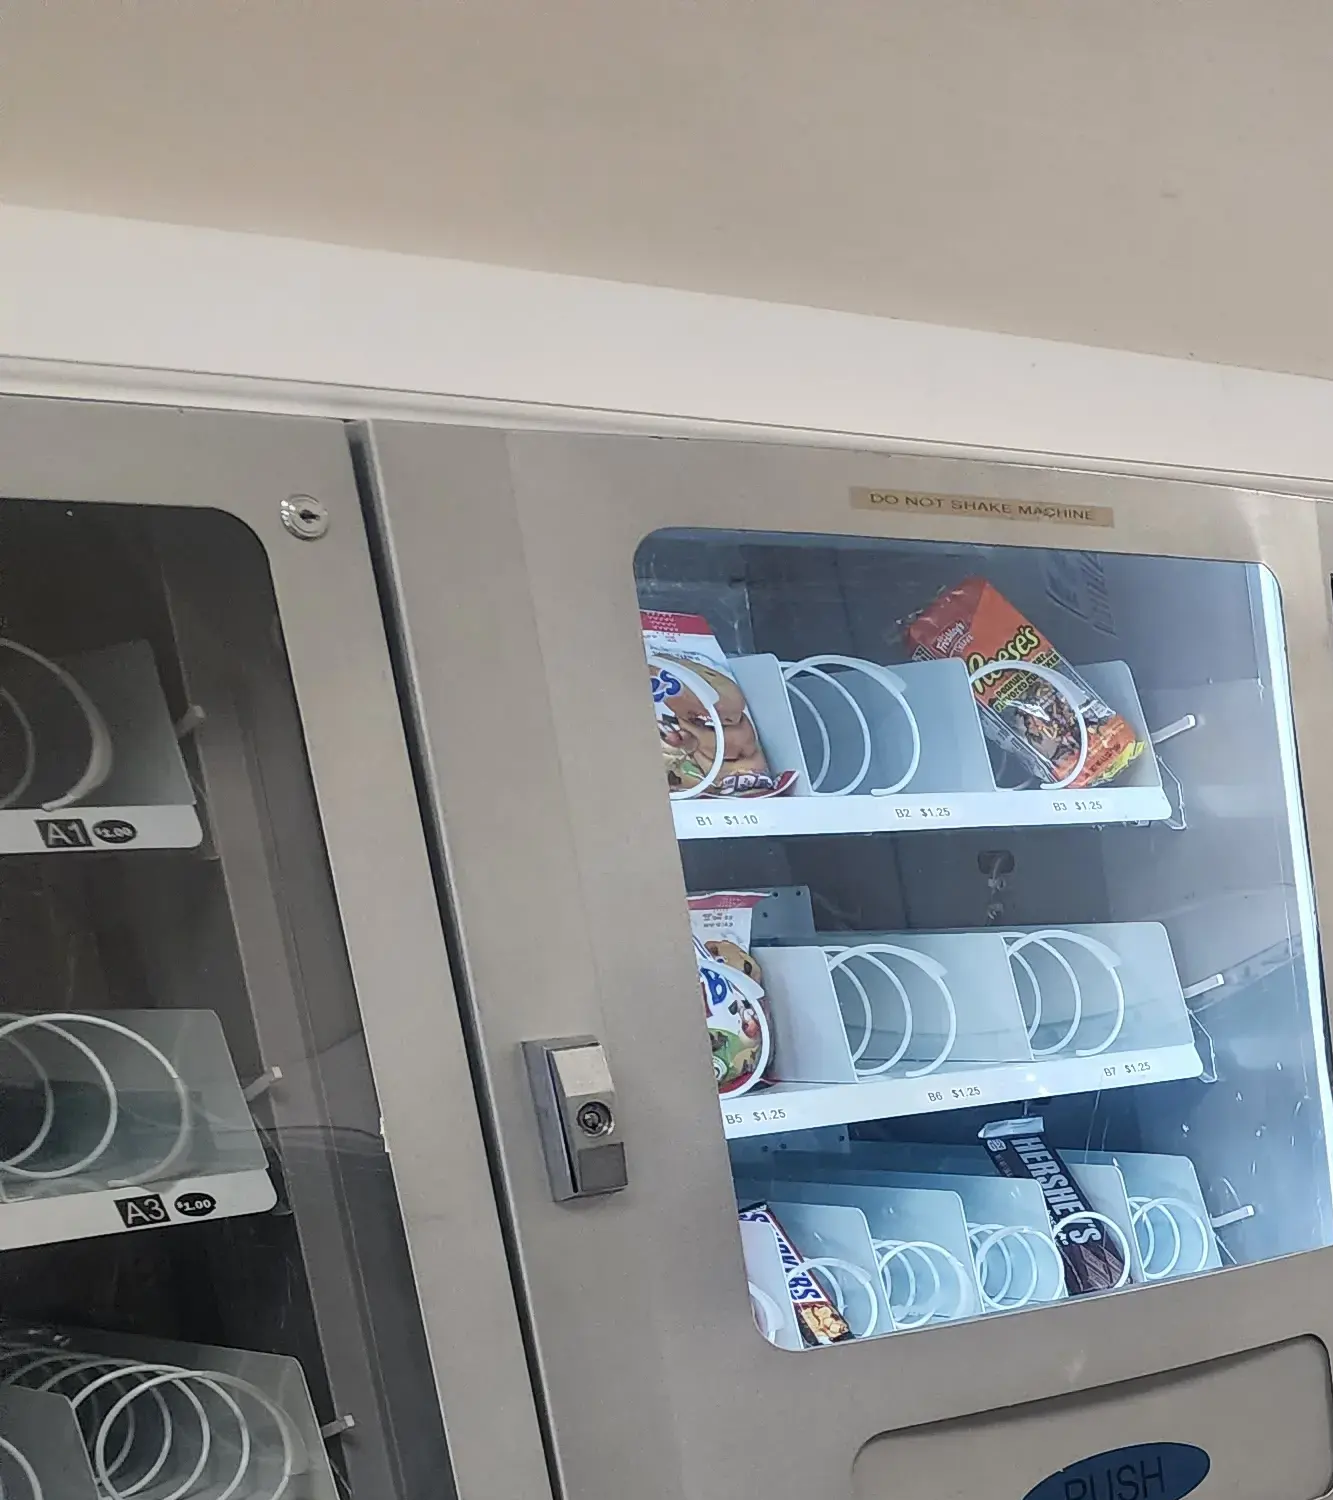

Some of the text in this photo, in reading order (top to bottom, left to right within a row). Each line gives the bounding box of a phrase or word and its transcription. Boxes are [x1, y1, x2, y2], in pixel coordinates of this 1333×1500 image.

[870, 493, 1094, 521] DO NOT SHAKE MACHINE
[894, 806, 951, 819] B2 $1.25
[1052, 800, 1103, 812] B3 $1.25
[696, 814, 759, 827] B1 $1.10
[47, 821, 87, 846] A1
[1104, 1061, 1151, 1078] B7 $1.25
[927, 1086, 981, 1103] B6 $1.25
[725, 1108, 787, 1125] B5 $1.25
[127, 1198, 212, 1225] A3 $1.00
